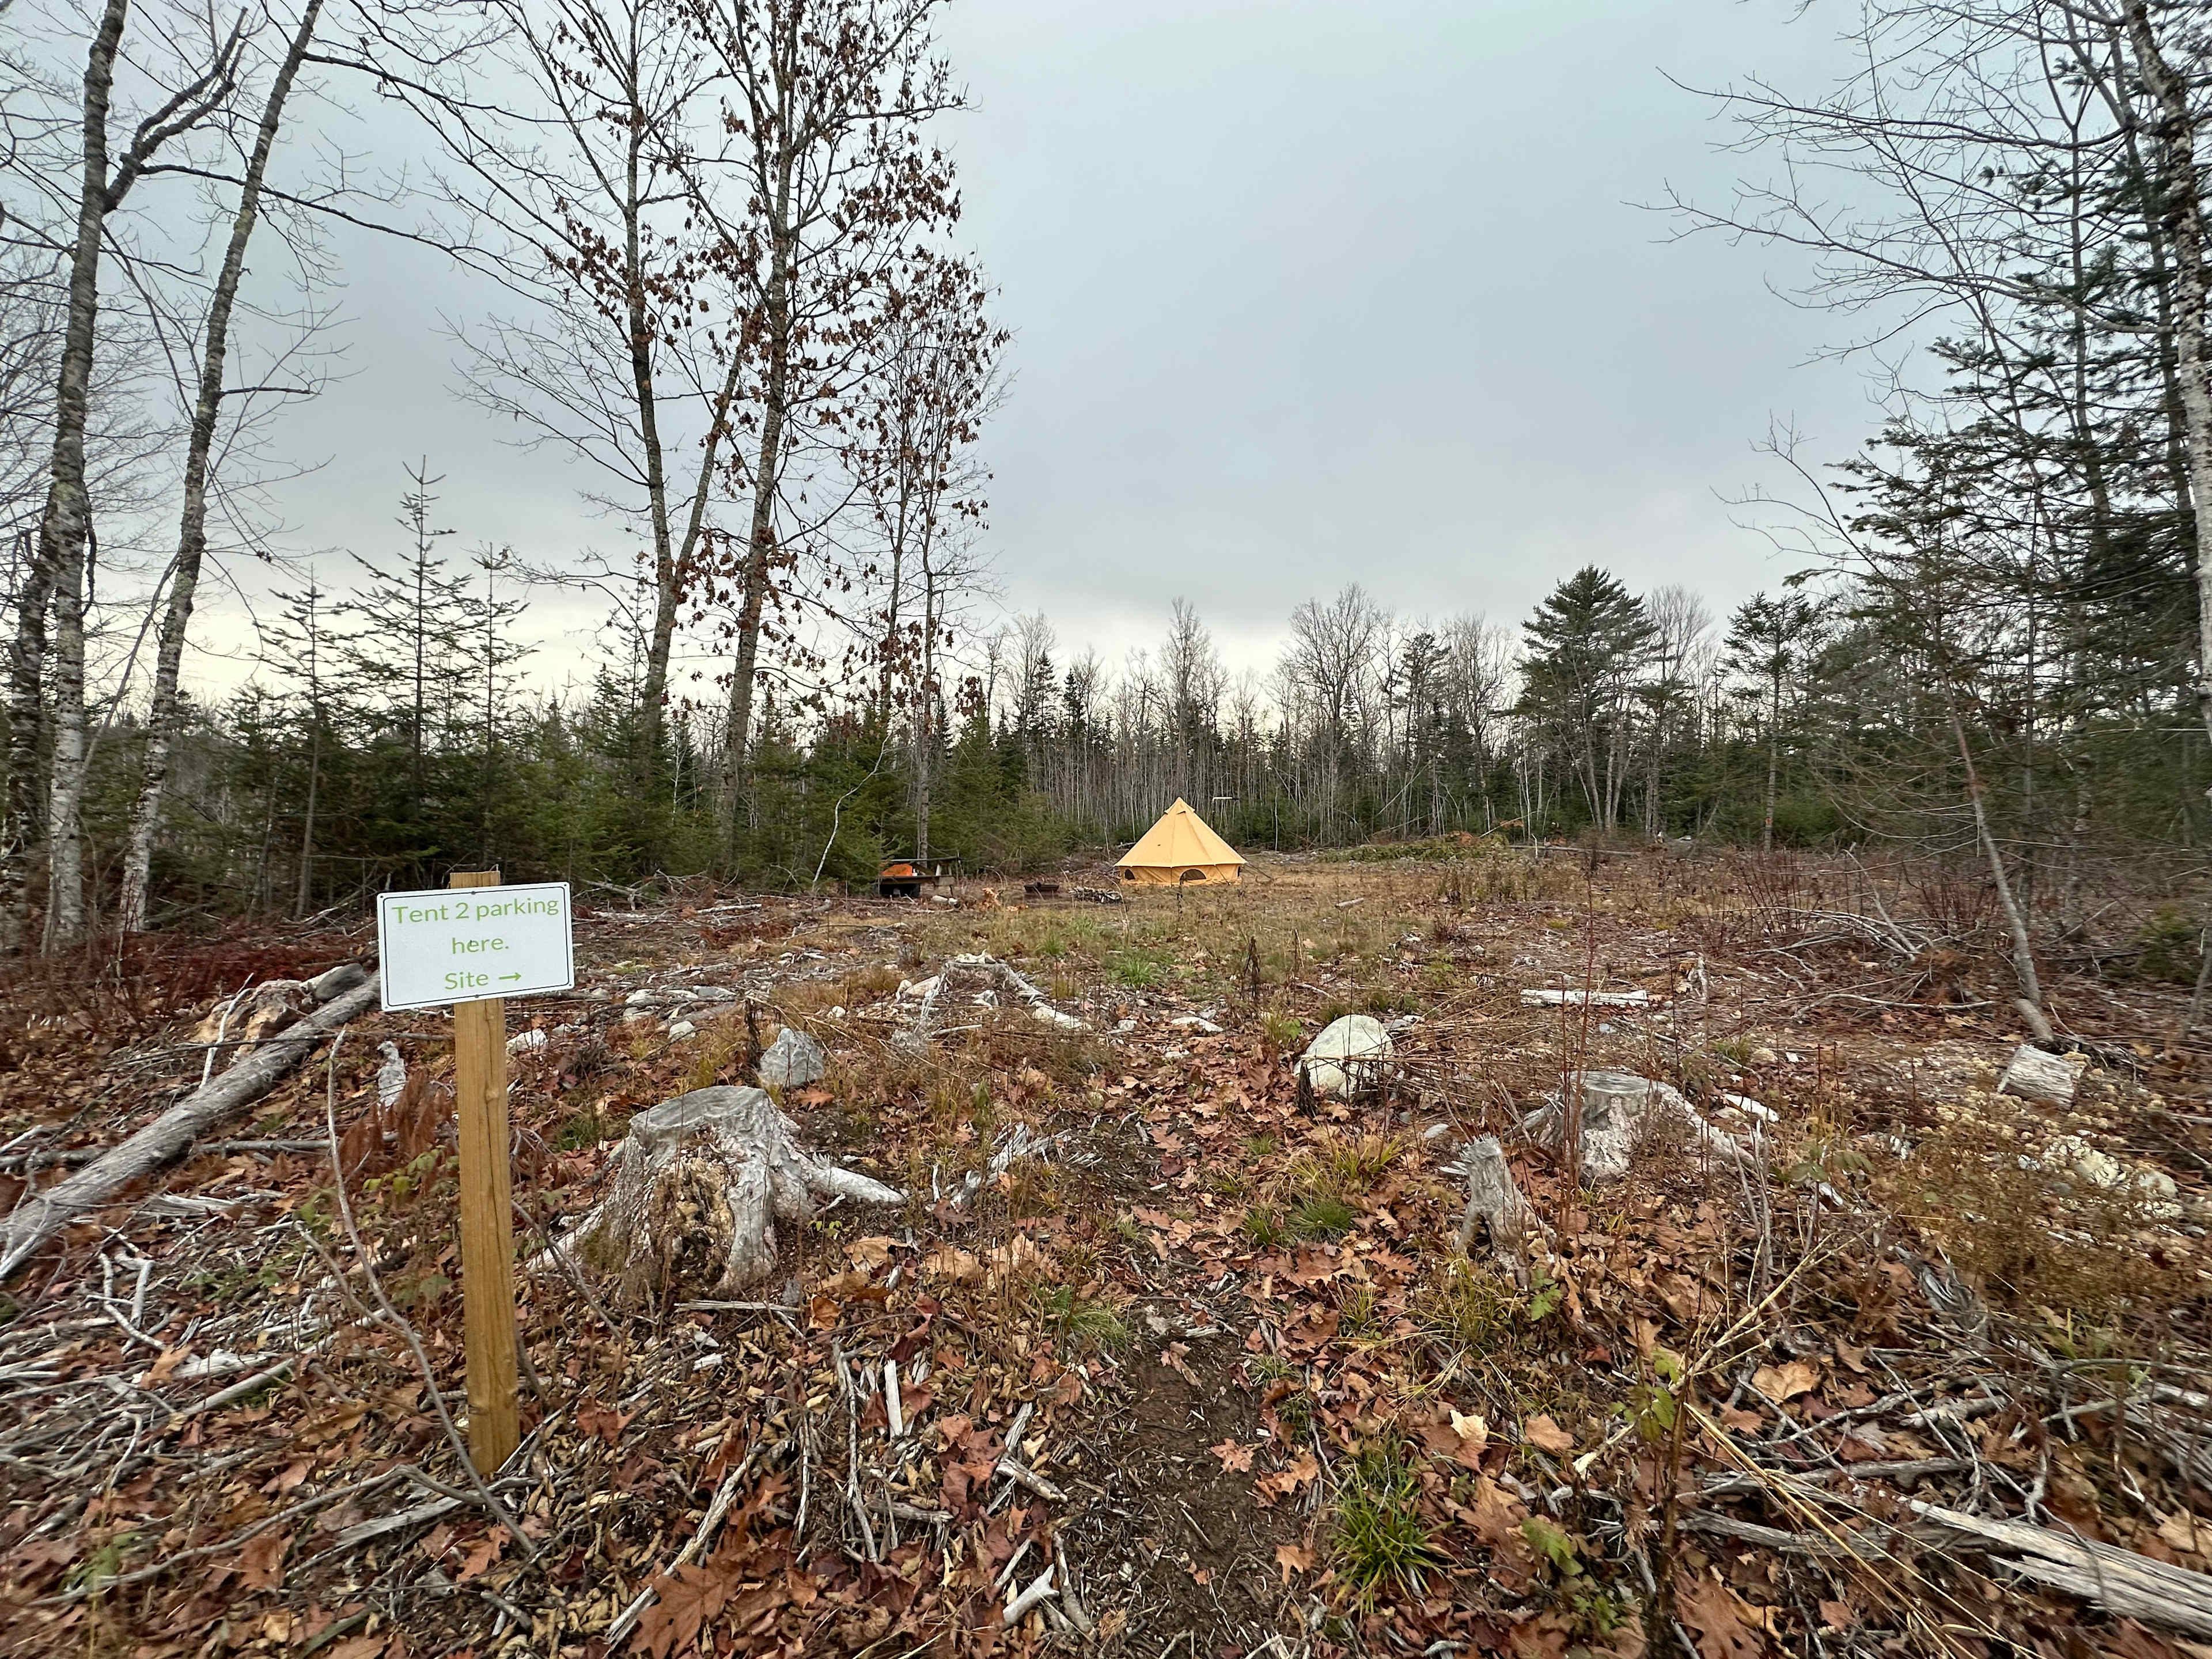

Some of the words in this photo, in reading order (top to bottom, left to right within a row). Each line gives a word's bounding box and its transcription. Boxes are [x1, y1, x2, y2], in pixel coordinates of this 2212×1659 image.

[392, 904, 448, 923] Tent
[456, 902, 469, 919] 2
[476, 897, 559, 921] parking
[452, 937, 509, 954] here.
[444, 972, 488, 990] Site
